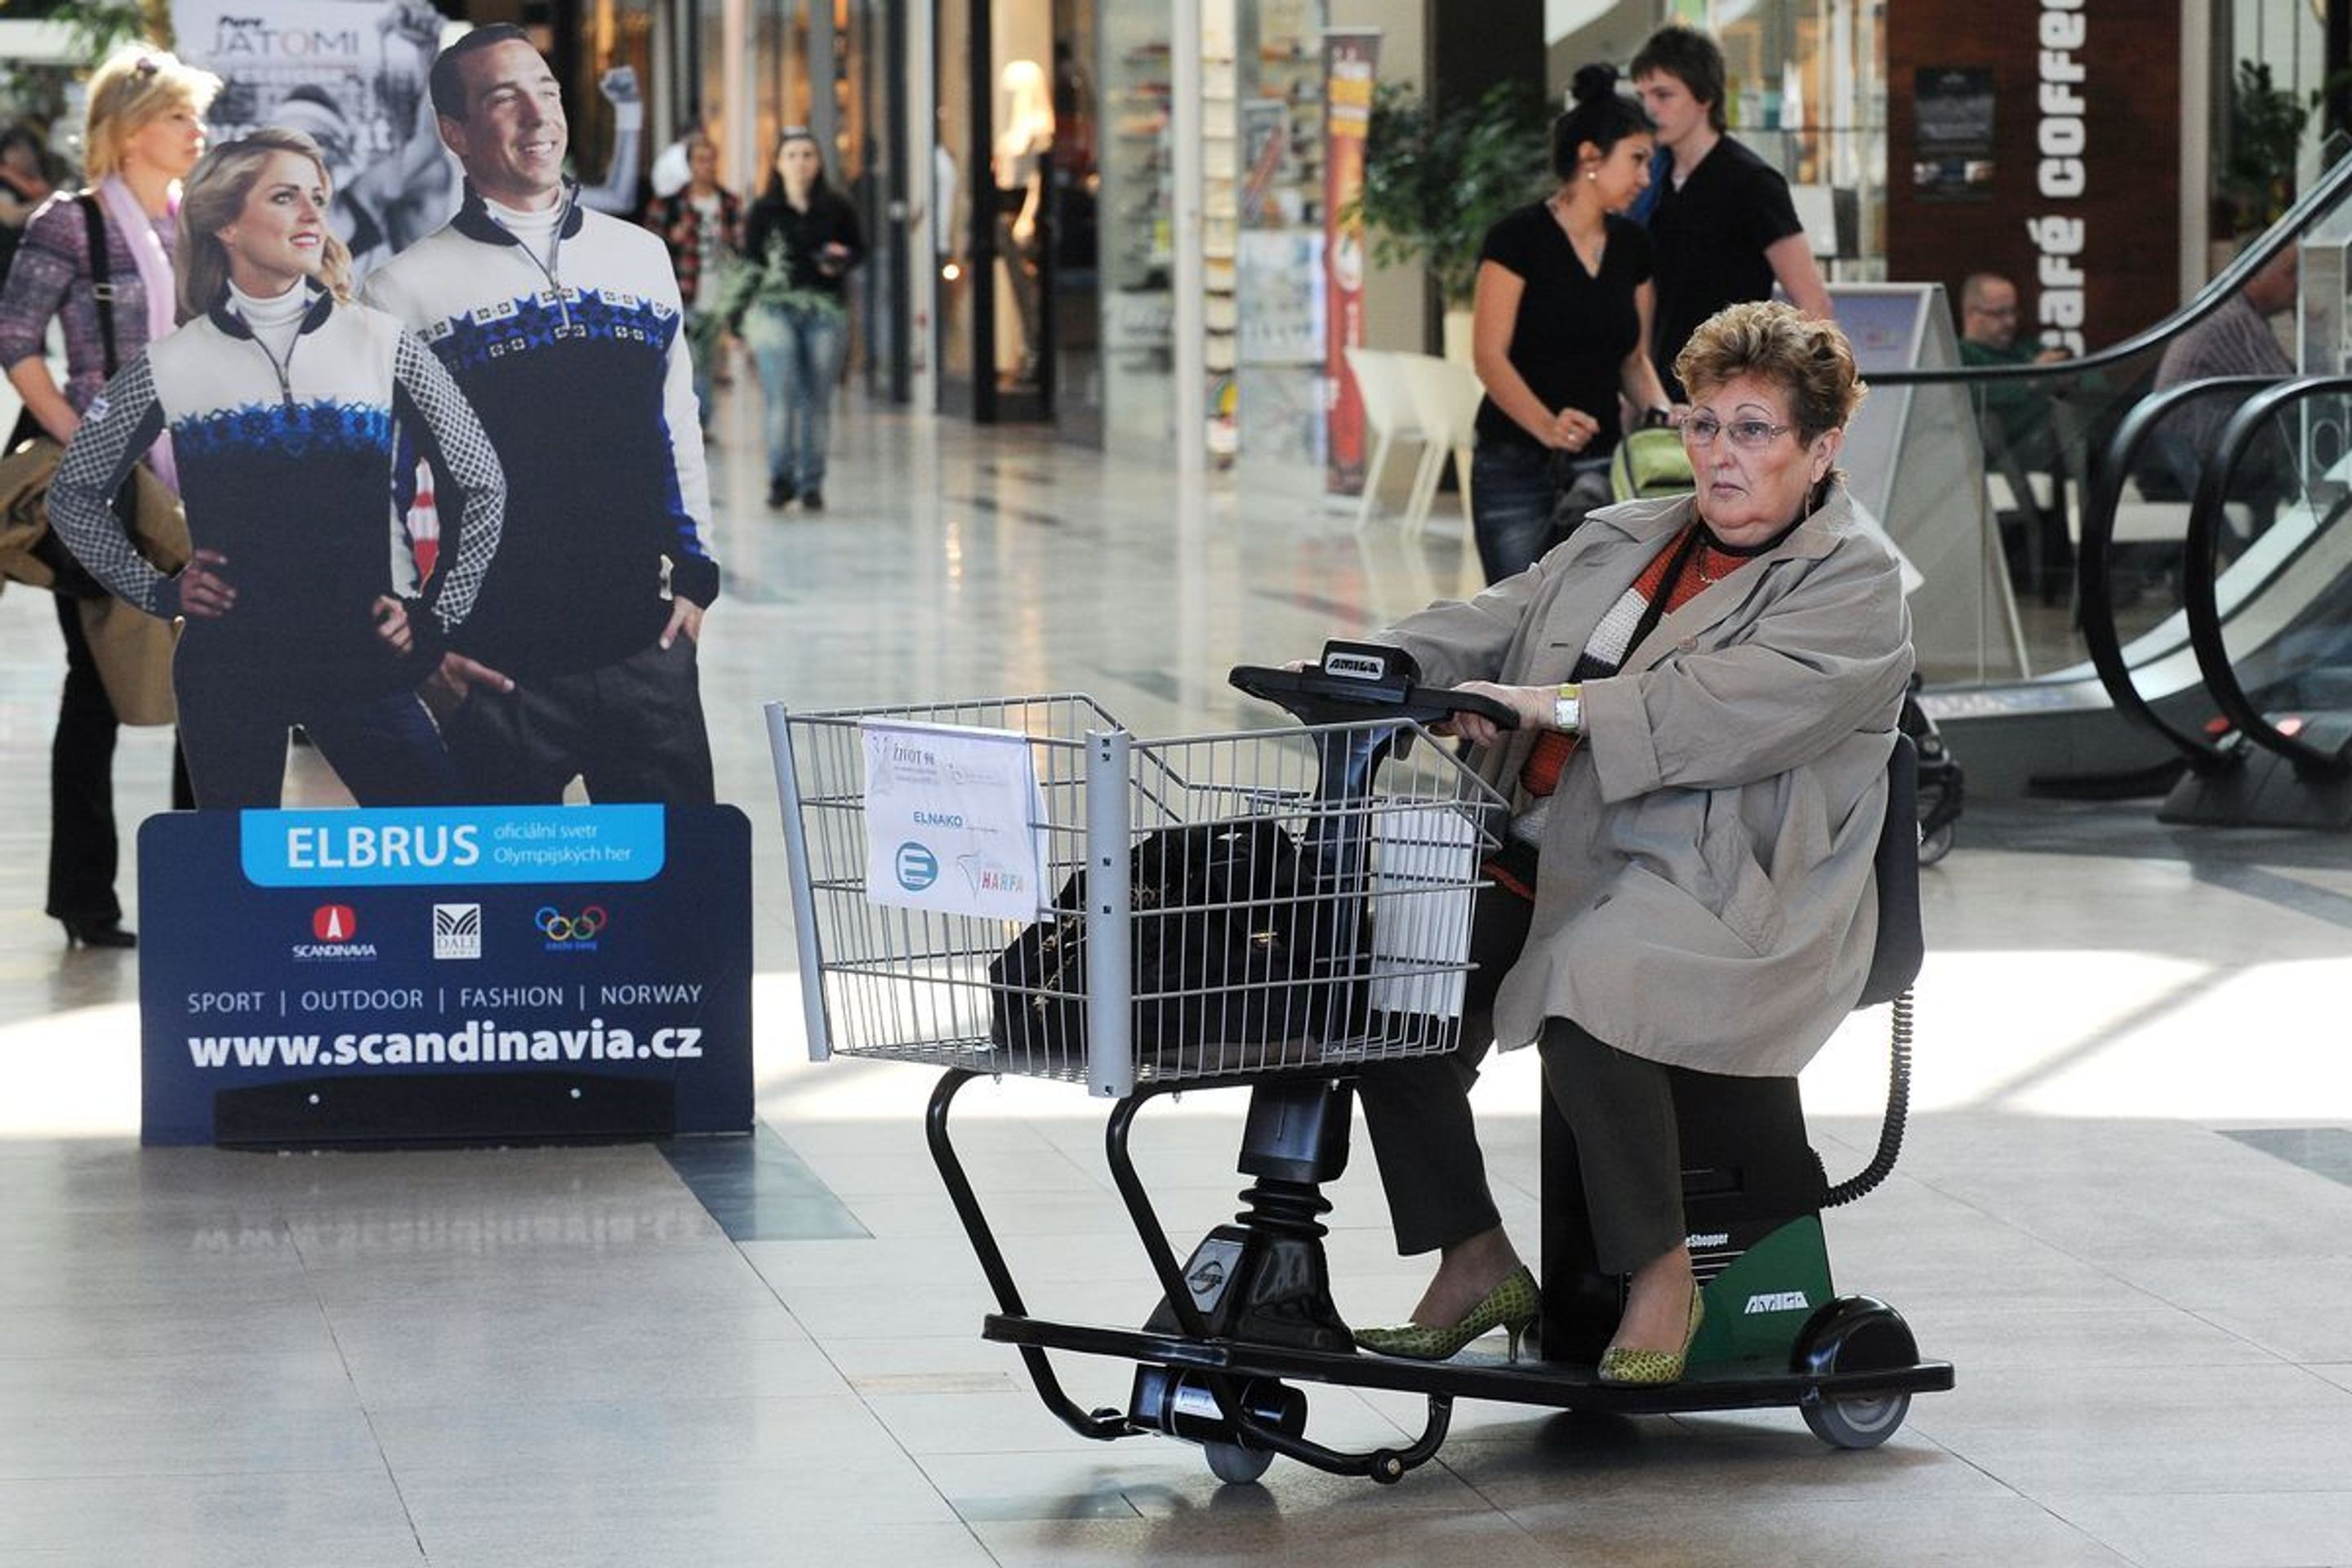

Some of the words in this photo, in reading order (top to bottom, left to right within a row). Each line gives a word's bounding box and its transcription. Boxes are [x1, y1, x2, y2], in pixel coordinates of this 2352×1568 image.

[206, 29, 359, 56] JATOMI
[559, 824, 598, 838] svetr
[912, 811, 964, 828] ELNAKO
[287, 825, 480, 868] ELBRUS
[493, 844, 601, 868] Olympijských
[605, 844, 631, 862] her
[292, 944, 377, 958] SCANDINAVIA
[187, 991, 265, 1013] SPORT
[301, 989, 423, 1011] OUTDOOR
[460, 987, 564, 1007] FASHION
[600, 985, 702, 1004] NORWAY
[187, 1018, 703, 1067] www.scandinavia.cz
